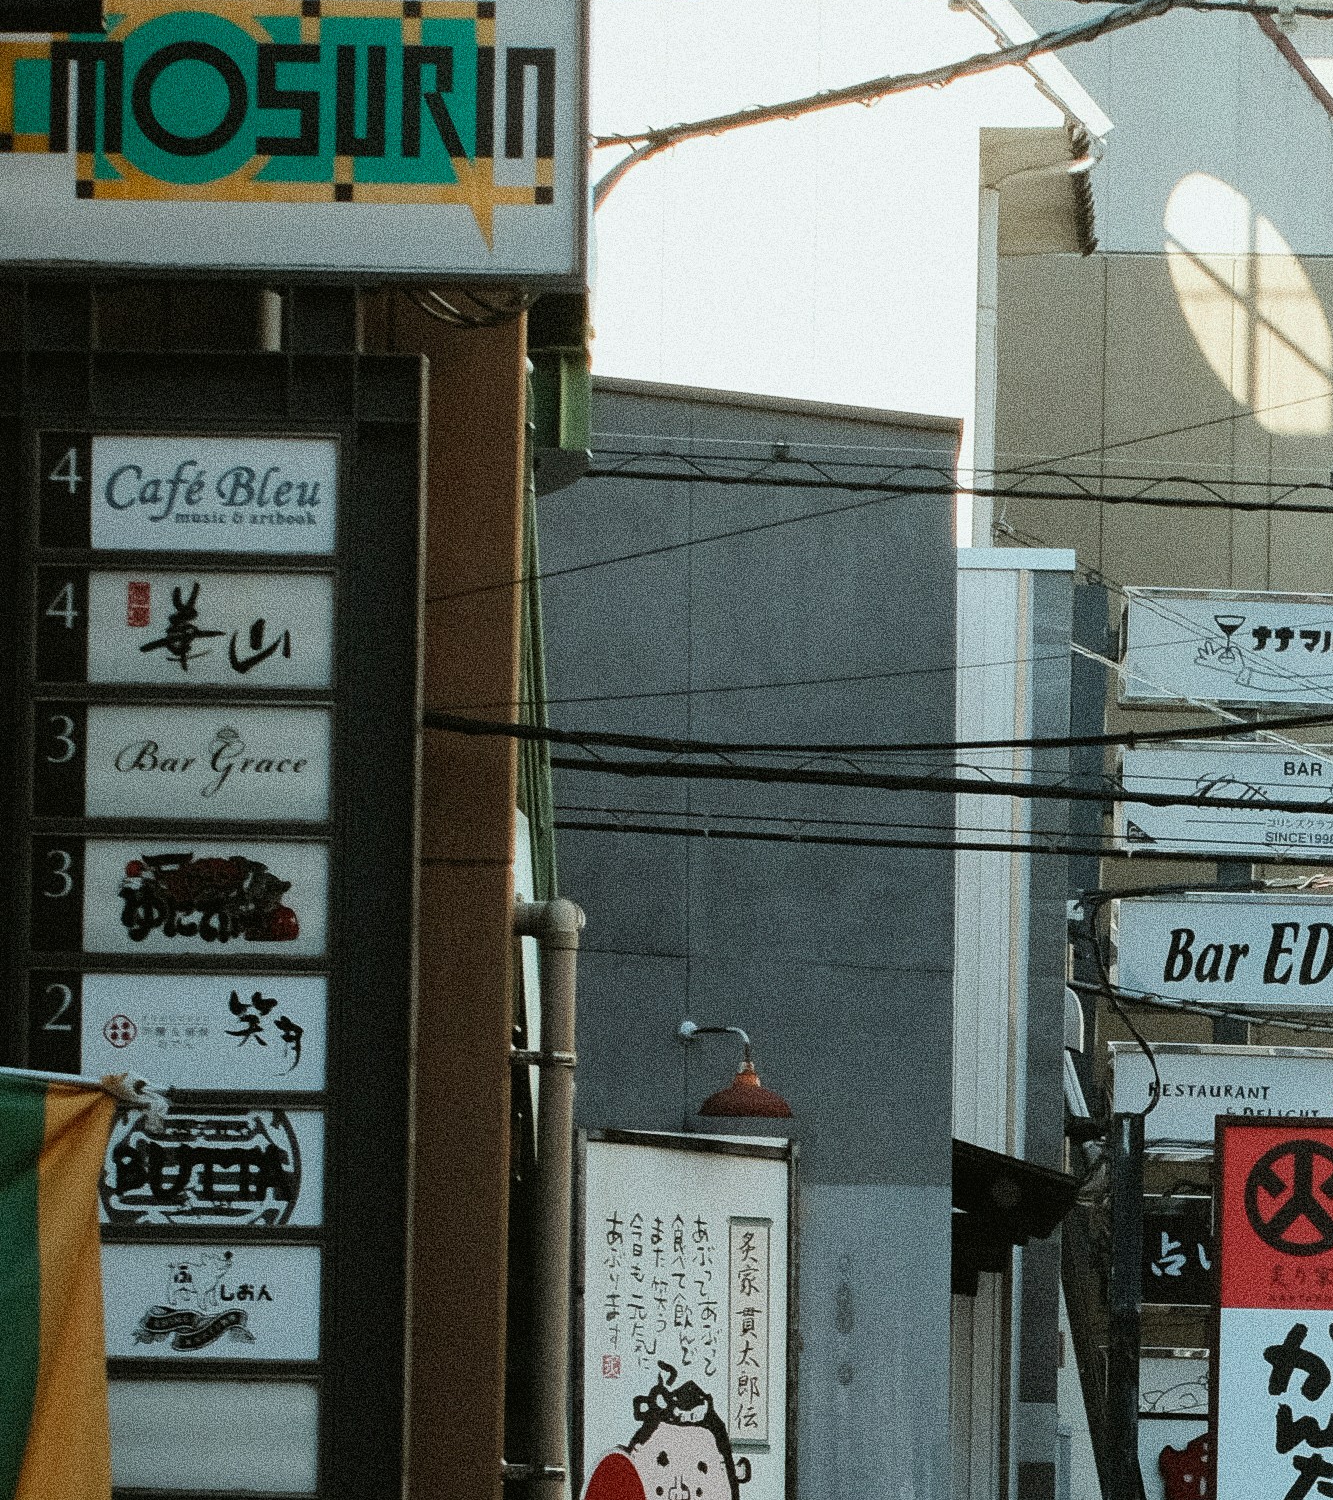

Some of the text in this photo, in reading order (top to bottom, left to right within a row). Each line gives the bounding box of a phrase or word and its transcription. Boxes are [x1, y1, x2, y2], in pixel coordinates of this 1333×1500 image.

[48, 445, 83, 495] 4
[106, 460, 322, 523] Café Bleu
[45, 581, 80, 631] 4
[46, 715, 78, 765] 3
[115, 730, 308, 799] Bar Grace
[1283, 761, 1323, 778] BAR
[43, 848, 75, 899] 3
[1163, 926, 1249, 985] Bar
[42, 981, 74, 1032] 2
